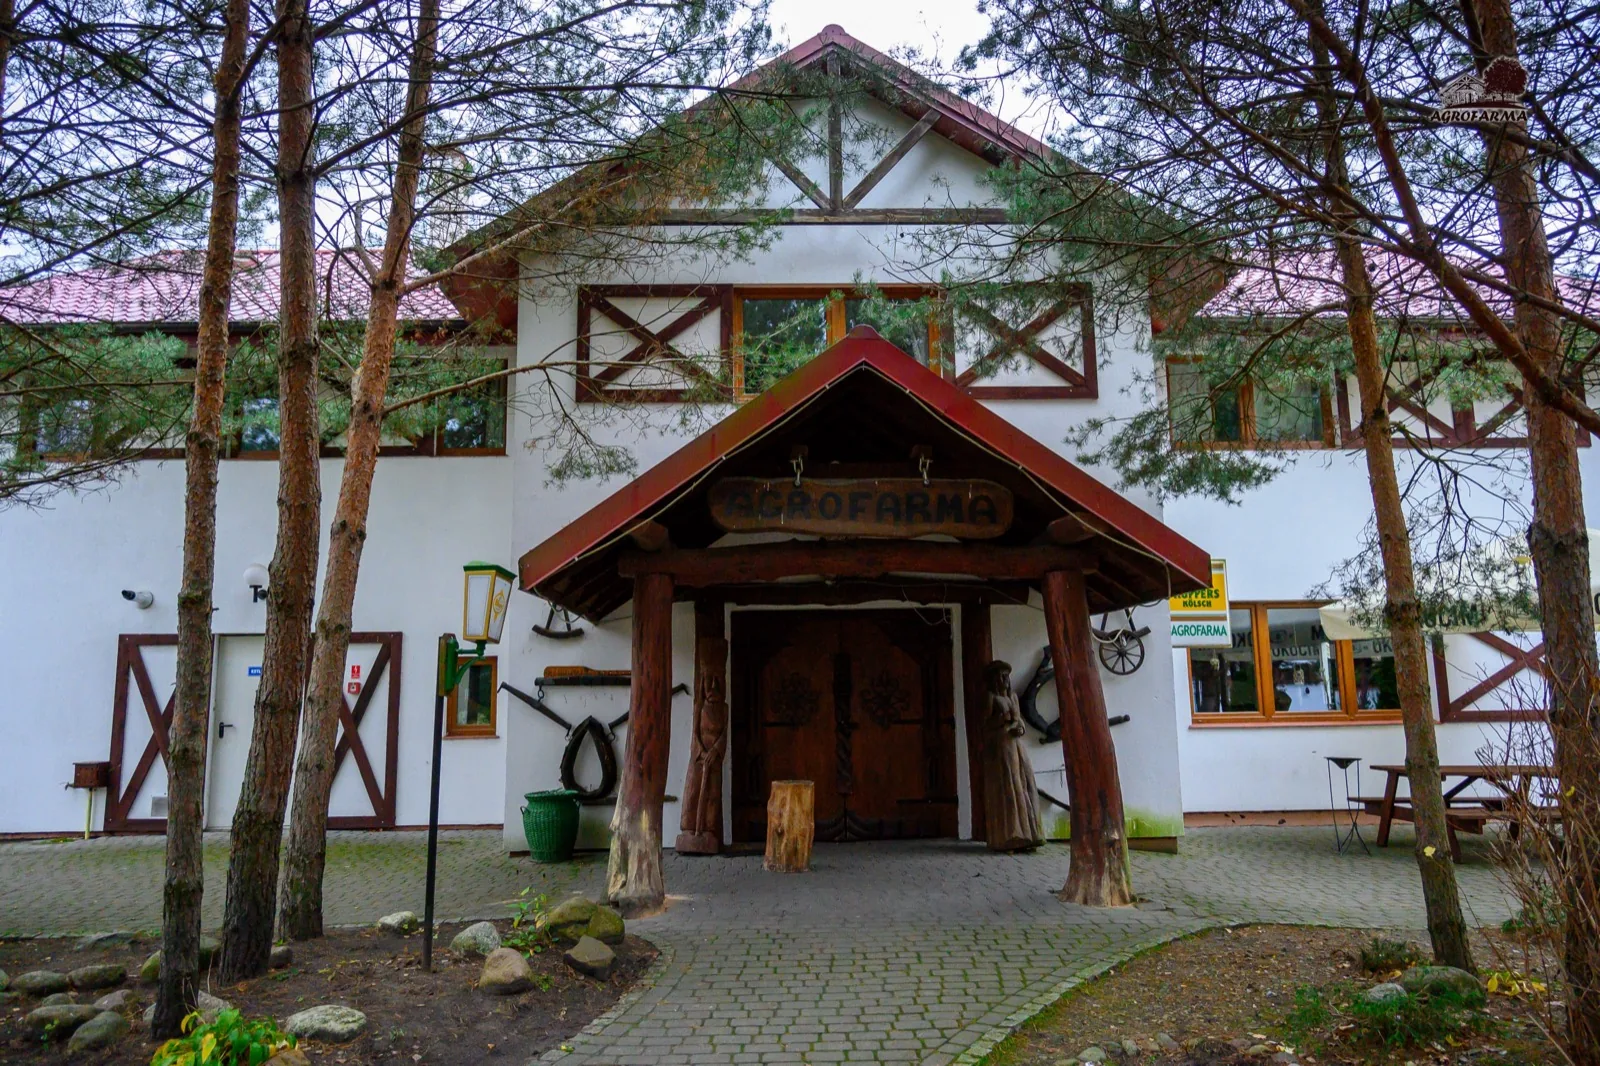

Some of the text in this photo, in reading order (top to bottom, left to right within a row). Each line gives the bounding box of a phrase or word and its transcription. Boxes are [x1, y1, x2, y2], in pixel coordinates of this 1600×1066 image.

[723, 490, 998, 524] AGROFARMA
[1174, 589, 1220, 599] PPERS
[1183, 599, 1212, 608] KÖLSCH
[1171, 624, 1228, 637] AGROFARMA
